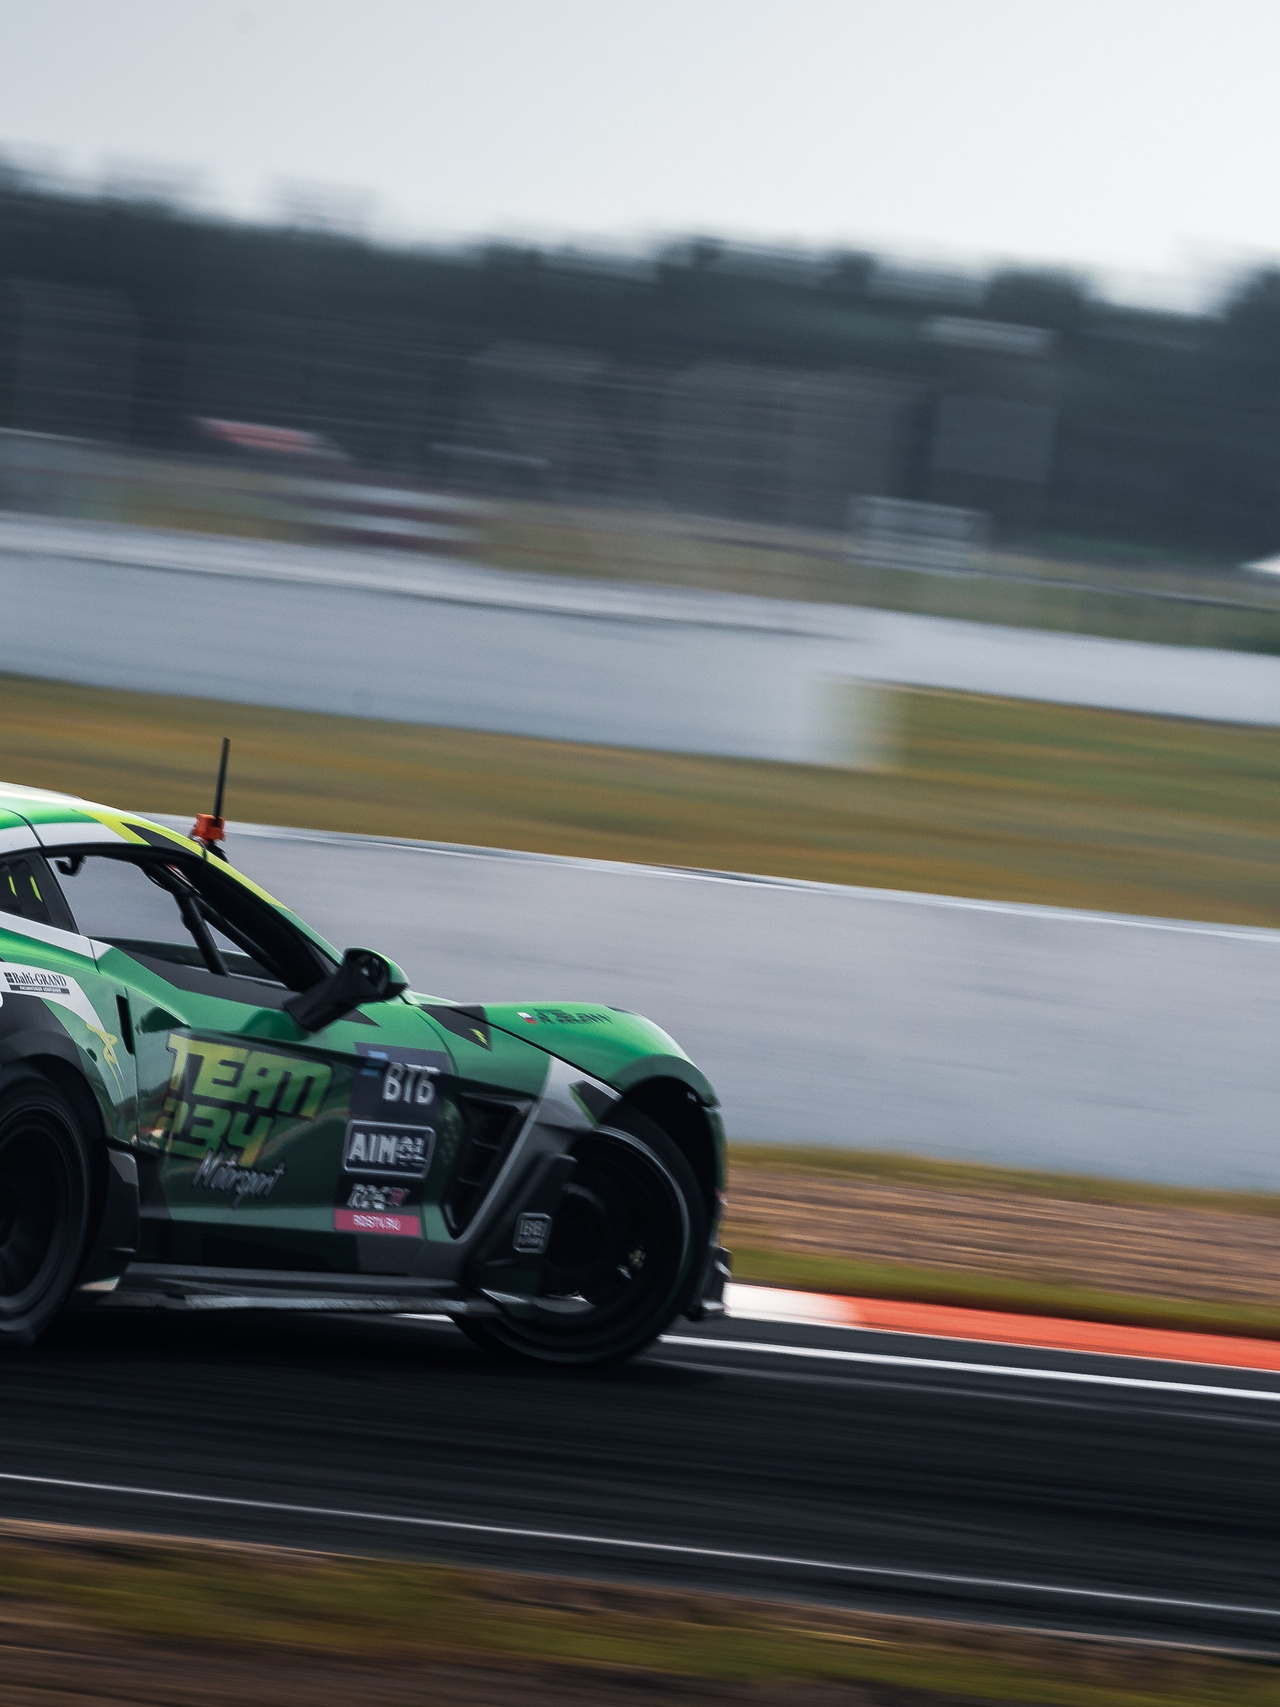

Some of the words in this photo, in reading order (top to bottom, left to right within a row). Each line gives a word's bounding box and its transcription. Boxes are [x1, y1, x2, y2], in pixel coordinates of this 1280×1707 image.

[11, 972, 67, 987] Balti-GRAND
[167, 1033, 333, 1120] TEAM
[192, 1148, 287, 1208] Motorsport
